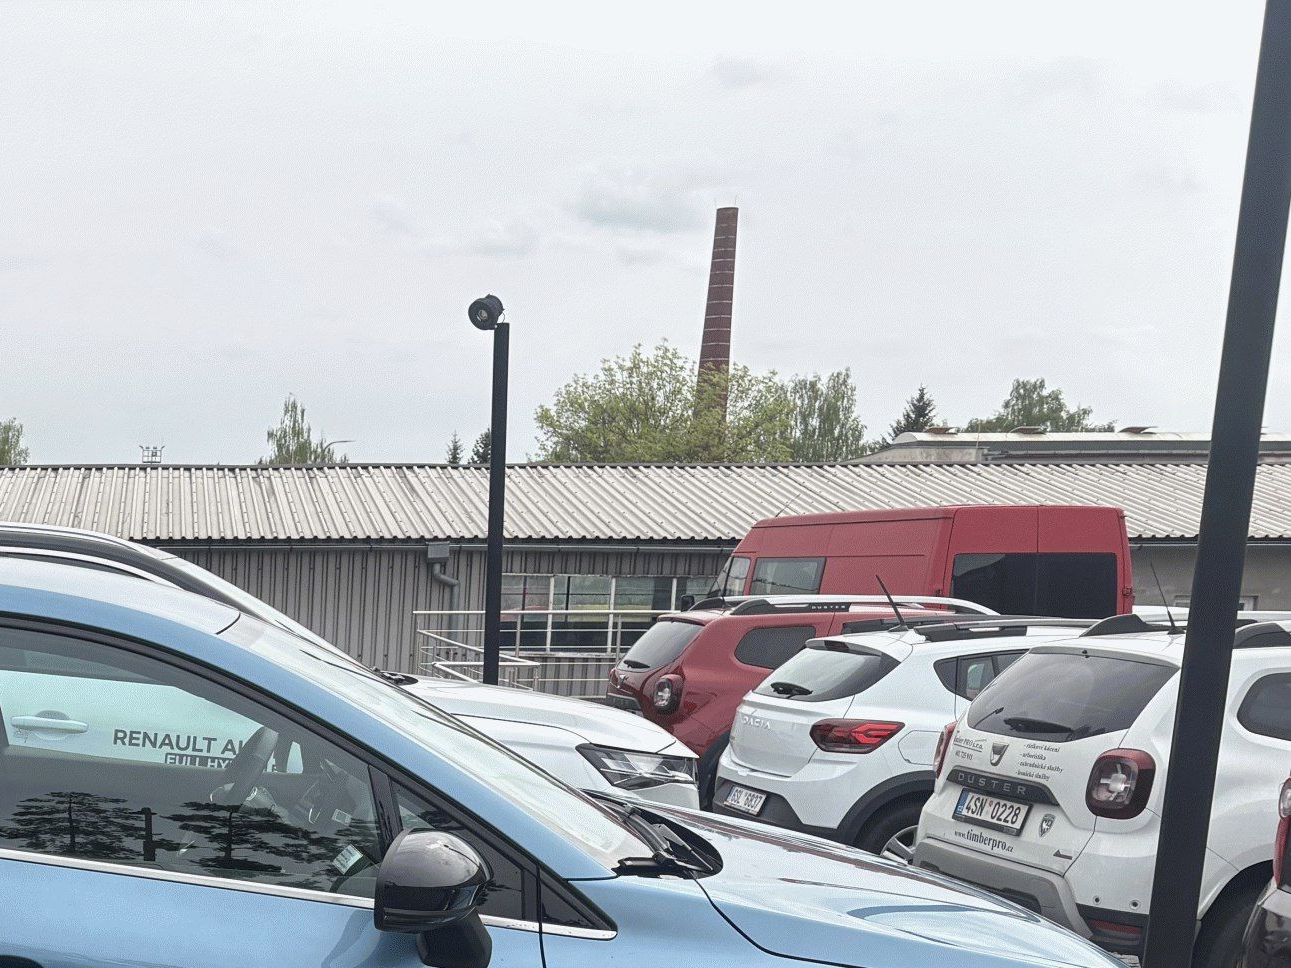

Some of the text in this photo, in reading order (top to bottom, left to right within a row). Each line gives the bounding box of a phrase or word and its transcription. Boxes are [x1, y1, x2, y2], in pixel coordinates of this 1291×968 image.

[741, 715, 771, 730] DACIA
[113, 729, 217, 754] RENAULT
[957, 772, 1027, 796] DUSTER
[965, 795, 988, 817] 4SN
[990, 801, 1021, 825] 0228
[954, 829, 1014, 853] www.timberpro.cz
